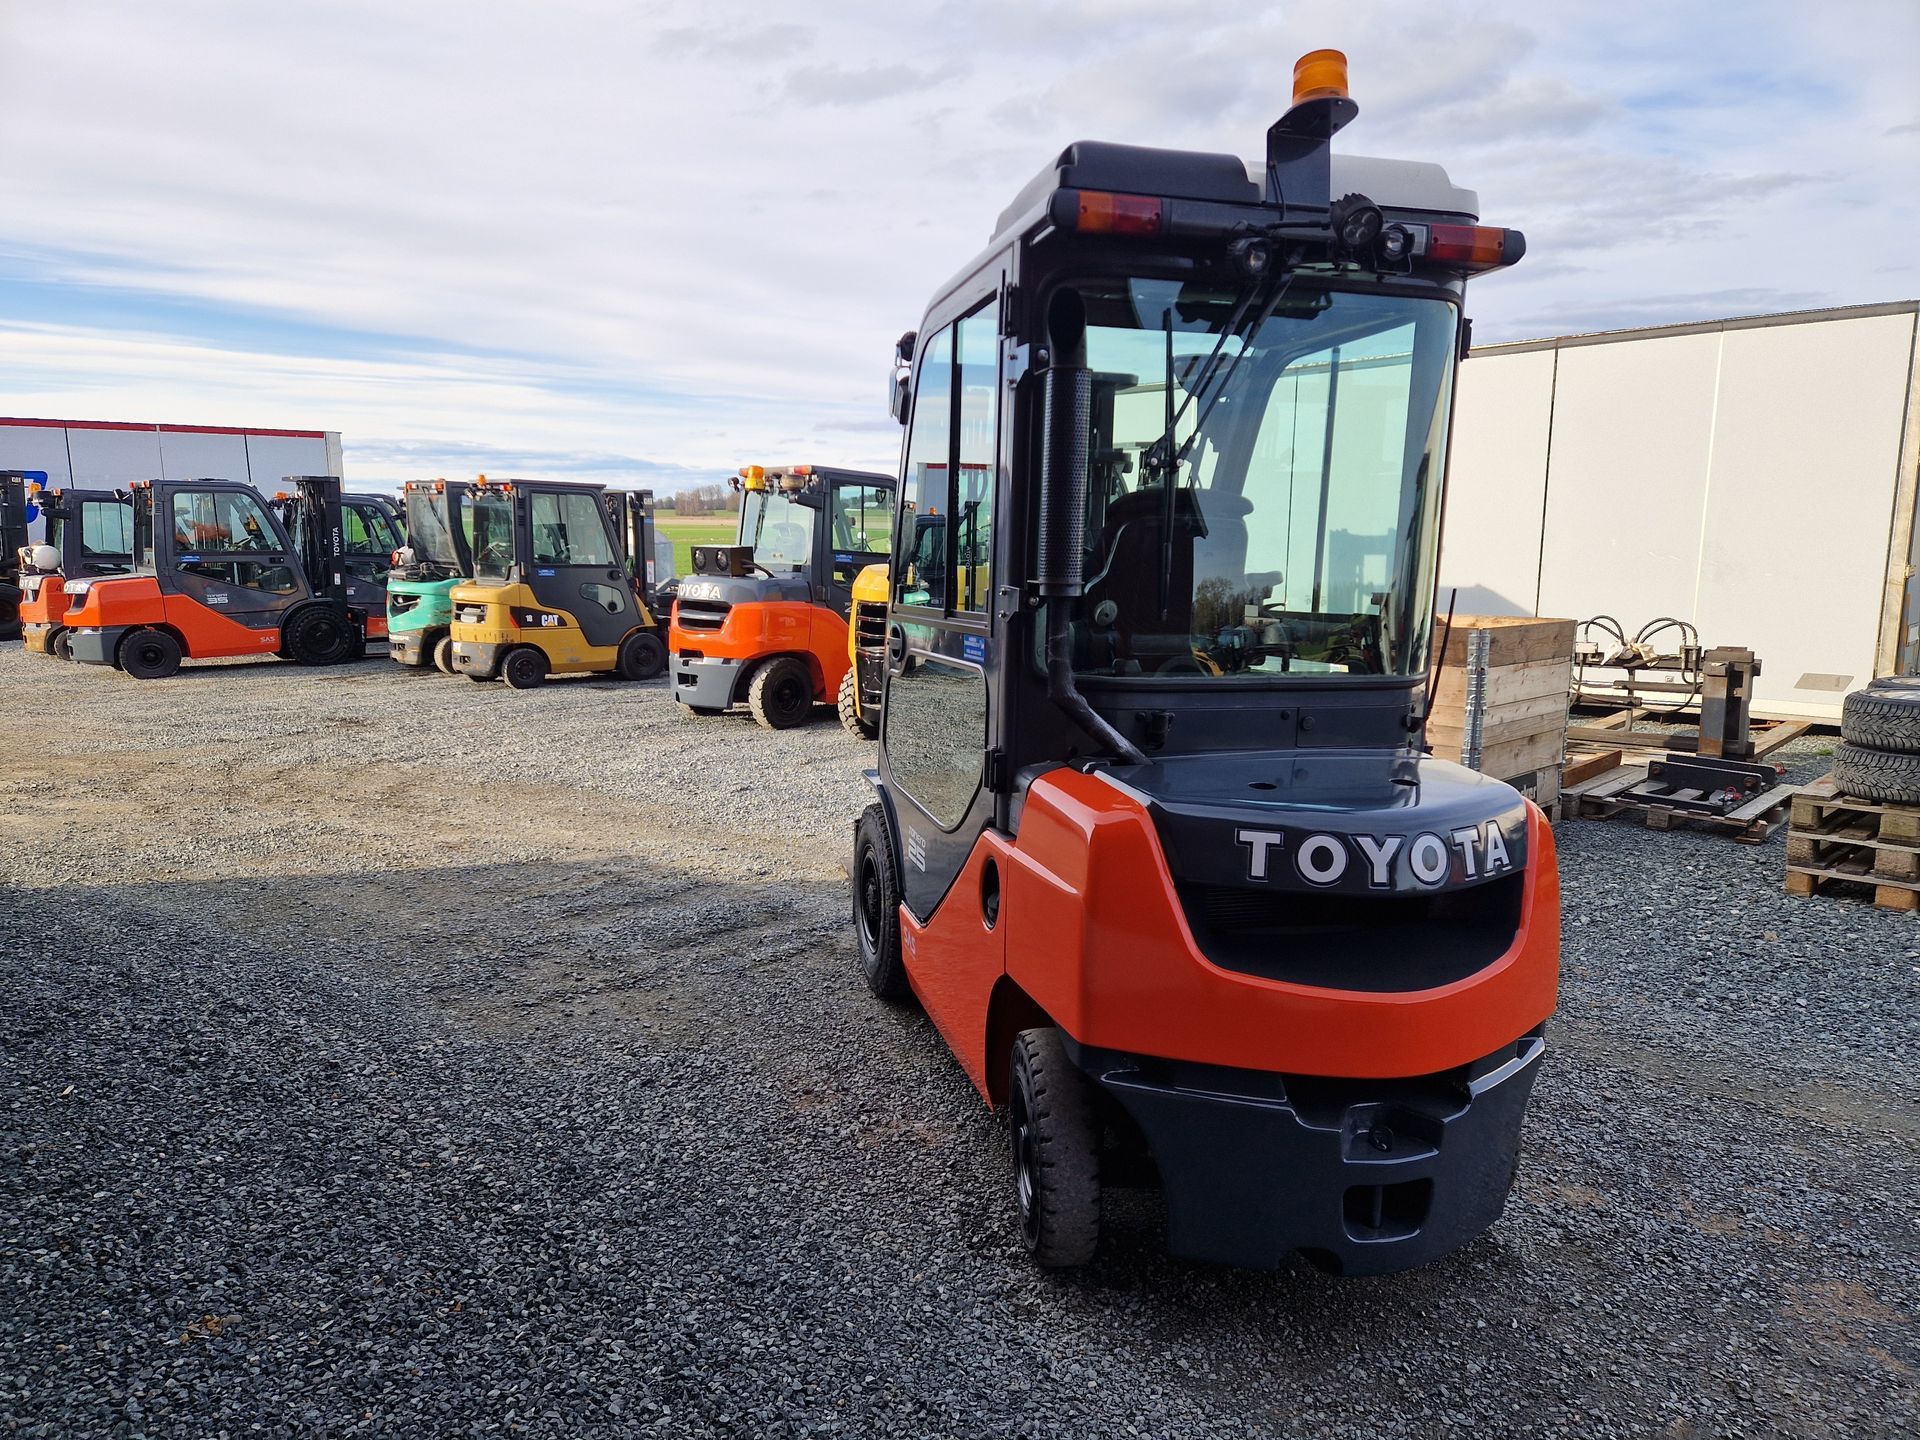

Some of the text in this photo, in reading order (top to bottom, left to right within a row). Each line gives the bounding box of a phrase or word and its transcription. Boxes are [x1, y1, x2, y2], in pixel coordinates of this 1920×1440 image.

[541, 614, 559, 626] CAT
[908, 837, 926, 873] 25
[1235, 820, 1511, 888] TOYOTA
